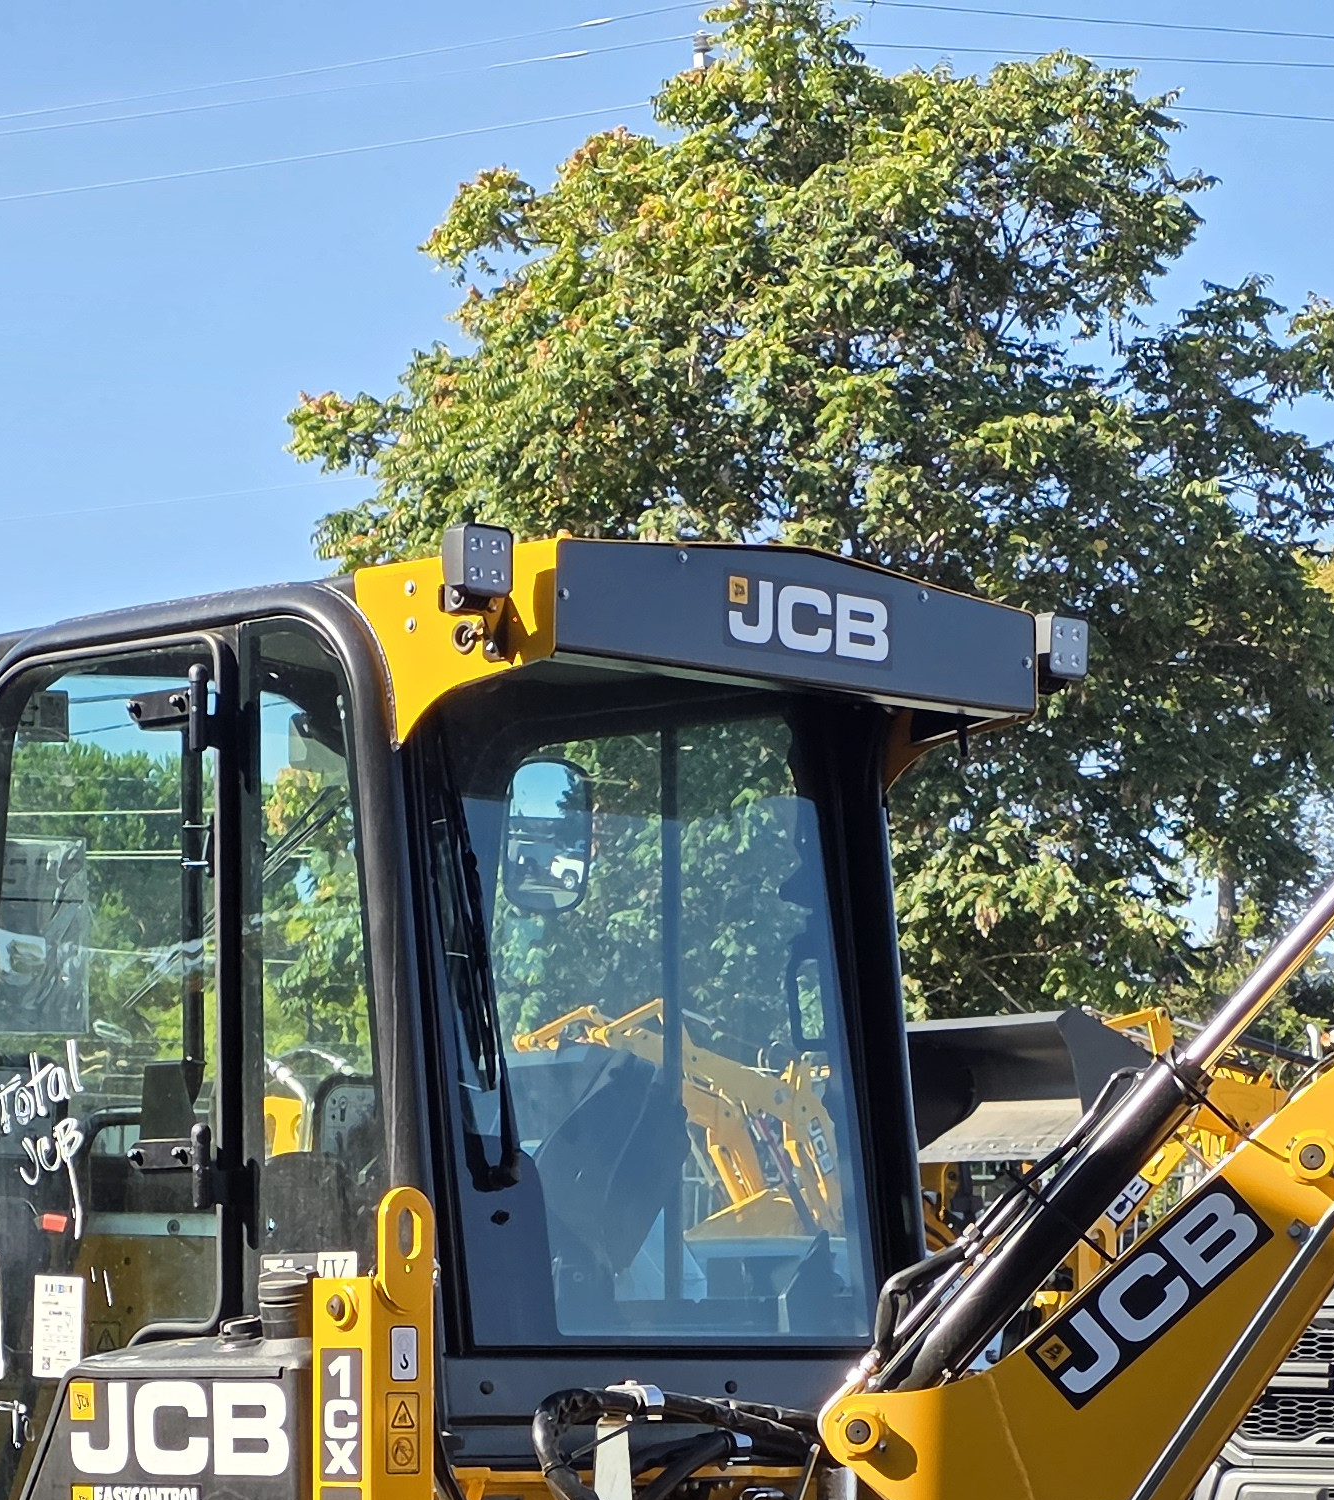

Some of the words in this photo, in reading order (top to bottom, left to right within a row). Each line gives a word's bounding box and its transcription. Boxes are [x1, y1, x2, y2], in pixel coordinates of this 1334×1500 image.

[729, 580, 889, 663] JCB
[1105, 1175, 1151, 1226] CB
[1059, 1192, 1258, 1394] JCB
[70, 1381, 290, 1476] JCB
[324, 1355, 358, 1475] 1CX
